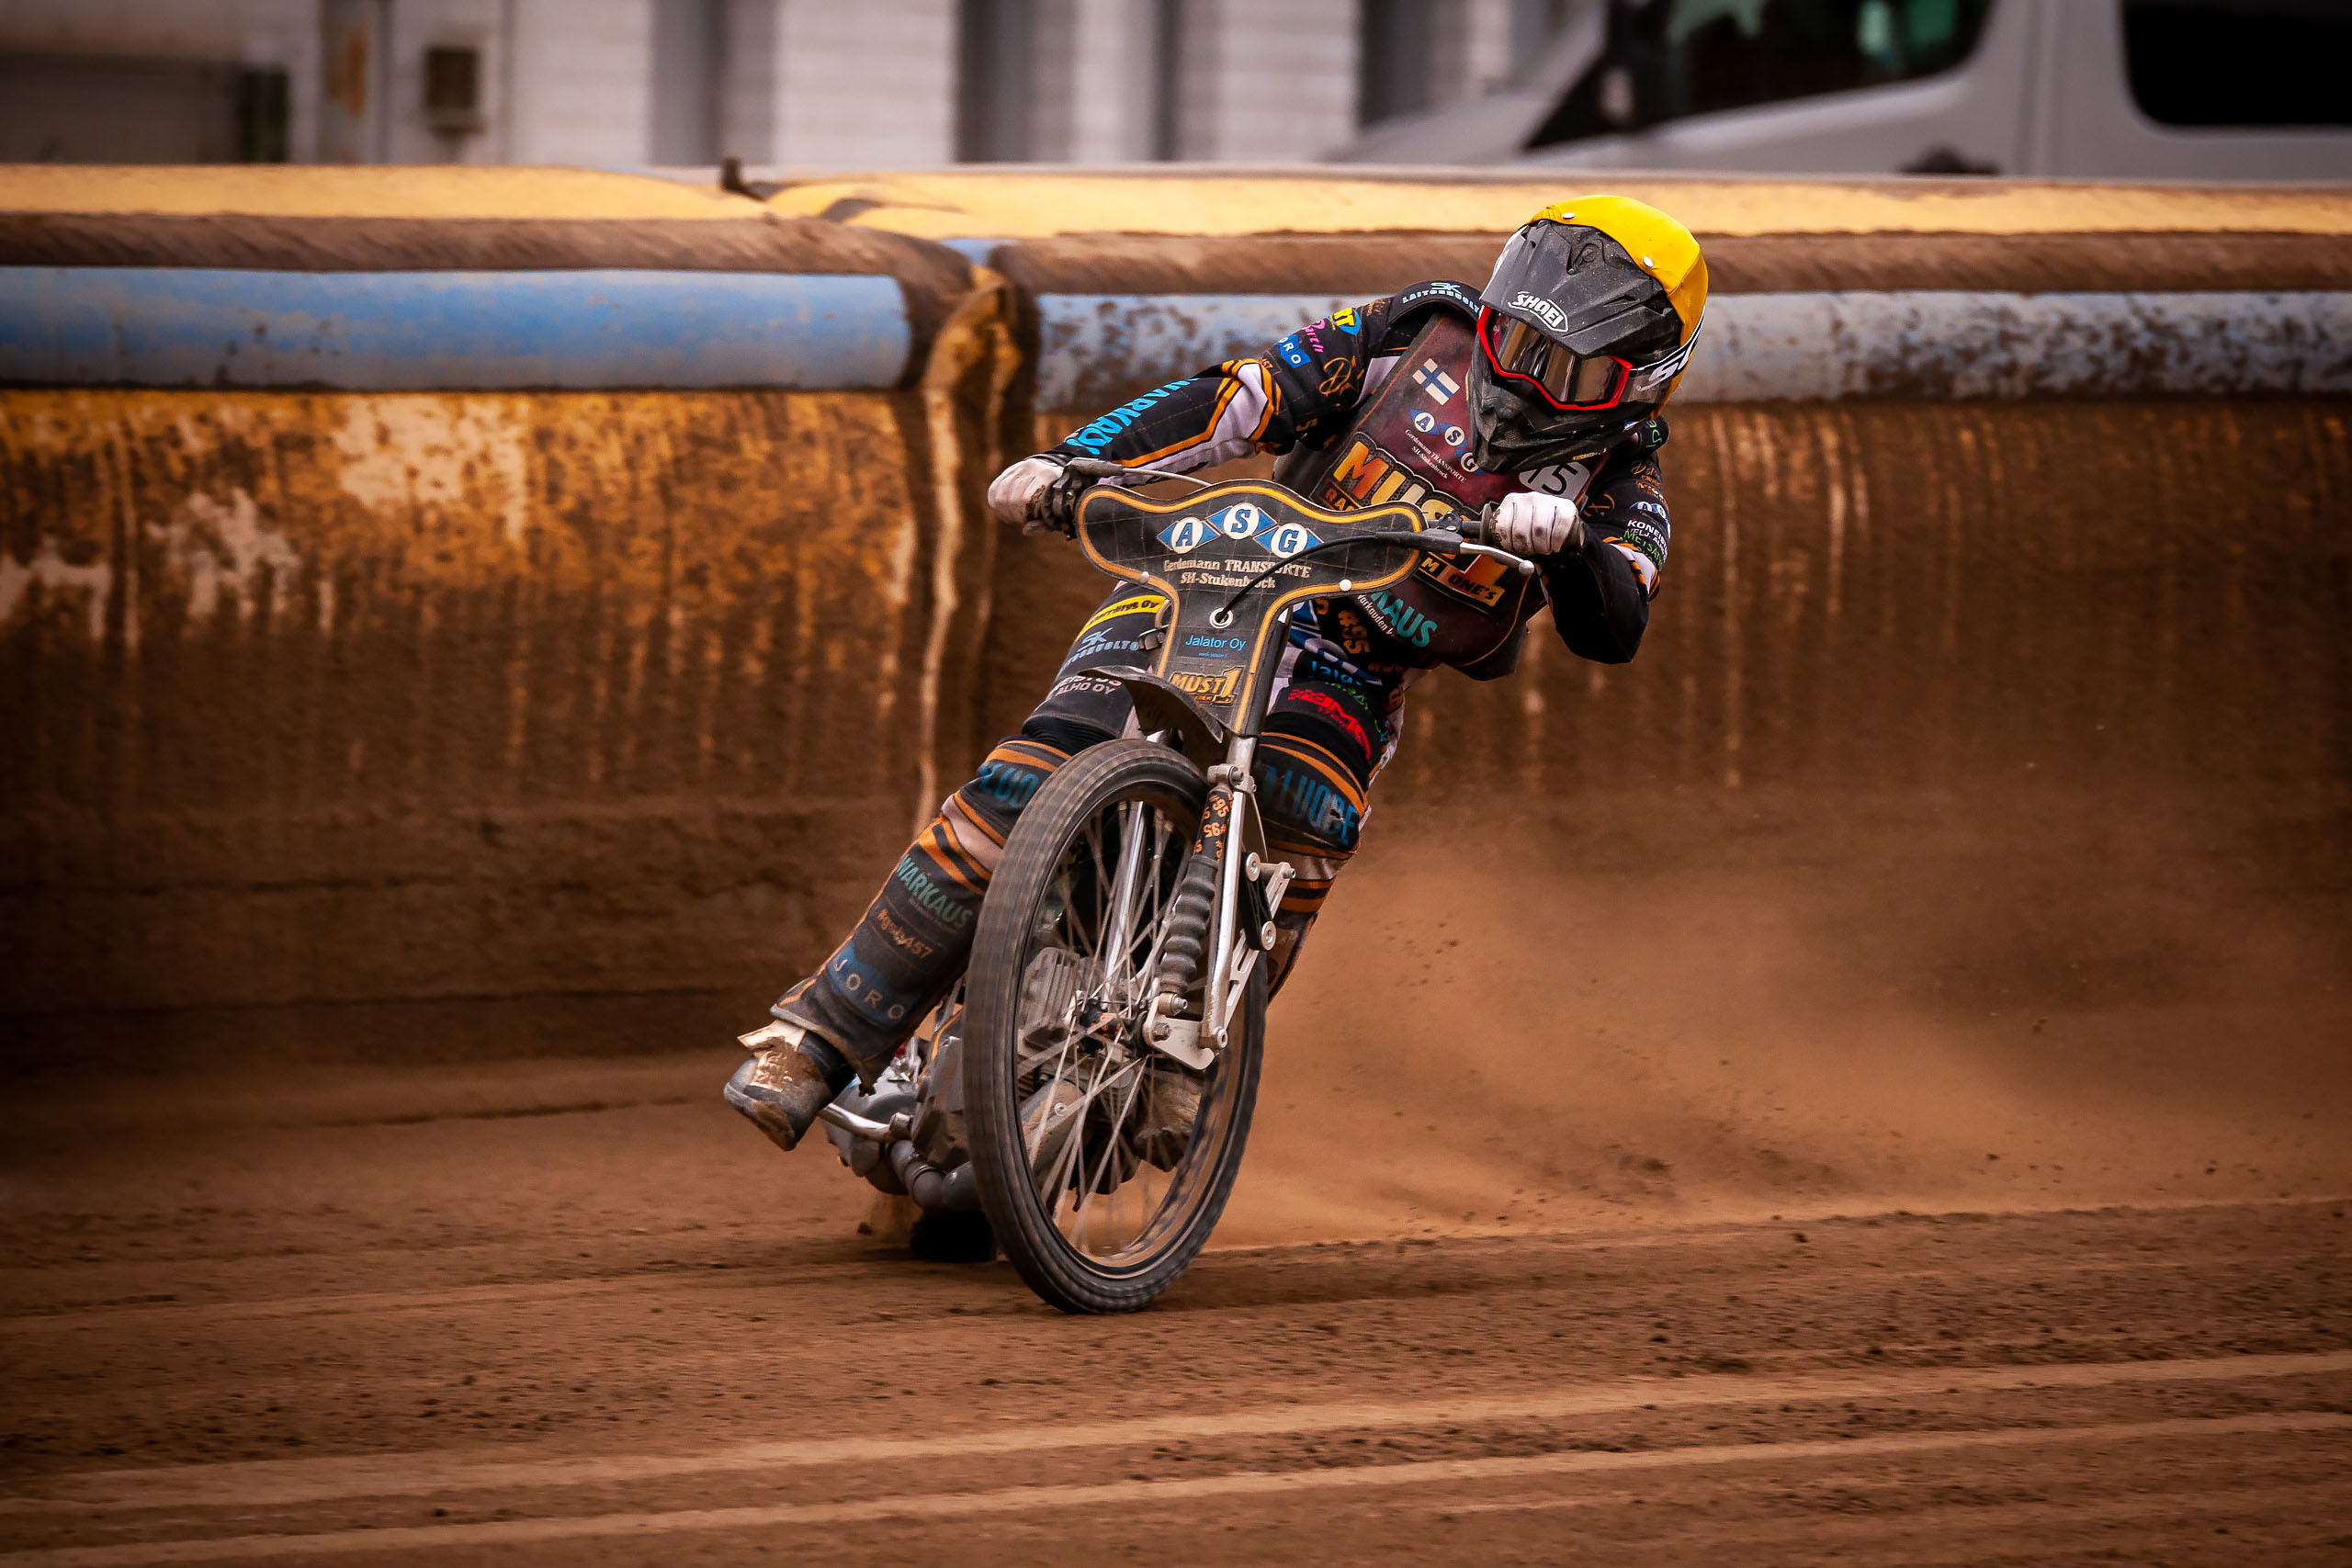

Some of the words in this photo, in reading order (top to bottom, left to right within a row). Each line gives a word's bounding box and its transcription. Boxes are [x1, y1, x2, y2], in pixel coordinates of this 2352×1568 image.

[1511, 292, 1565, 328] SHOEI
[1163, 558, 1220, 572] Gerdemann
[1181, 572, 1276, 589] SH-Stukenbock
[1448, 573, 1497, 600] ONE'S
[1185, 635, 1227, 649] Jalator
[1229, 637, 1247, 651] Oy
[1091, 683, 1115, 695] OY
[896, 853, 973, 928] WARKAUS
[834, 958, 905, 1020] JORO
